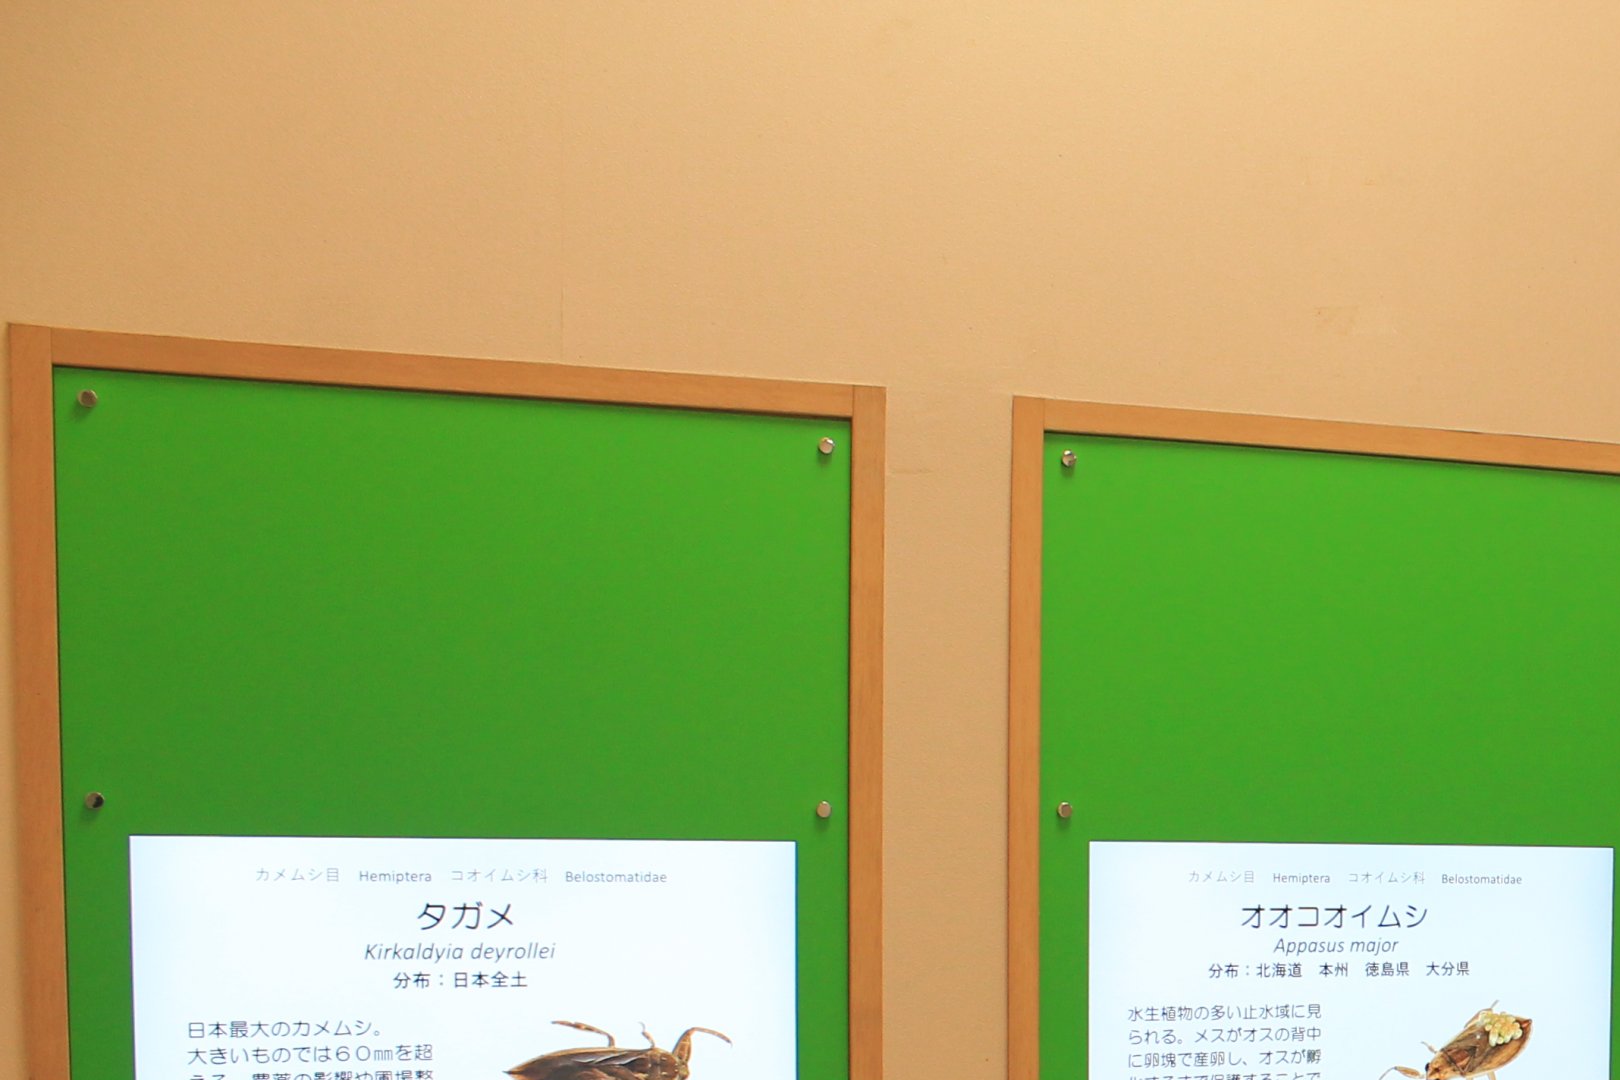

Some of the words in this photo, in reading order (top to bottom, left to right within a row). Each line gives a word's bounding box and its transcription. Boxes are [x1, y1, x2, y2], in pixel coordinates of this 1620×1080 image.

[255, 867, 340, 883] カメムシ目
[359, 869, 432, 884] Hemiptera
[450, 867, 548, 883] コオイムシ科
[565, 869, 667, 883] Belostomatidae
[1188, 870, 1255, 883] カメムシ目
[1273, 871, 1331, 885] Hemiptera
[1348, 870, 1425, 884] コオイムシ科
[1442, 873, 1522, 885] Belostomatidae
[418, 902, 515, 930] タガメ
[1242, 905, 1428, 929] オオコオイムシ
[365, 942, 463, 963] Kirkaldyia
[471, 942, 555, 963] deyrollei
[1274, 938, 1344, 955] Appasus
[1350, 938, 1399, 955] major
[1208, 962, 1302, 979] 分布：北海道
[1319, 963, 1348, 978] 本州
[1365, 962, 1409, 977] 徳島県
[1426, 961, 1469, 976] 大分県
[393, 971, 528, 989] 分布：日本全土
[1127, 1003, 1322, 1022] 水生植物の多い止水域に見
[188, 1018, 384, 1040] 日本最大のカメムシ。
[1129, 1026, 1321, 1046] られる。メスがオスの背中
[1128, 1049, 1321, 1068] に卵塊で産卵し、オスが孵
